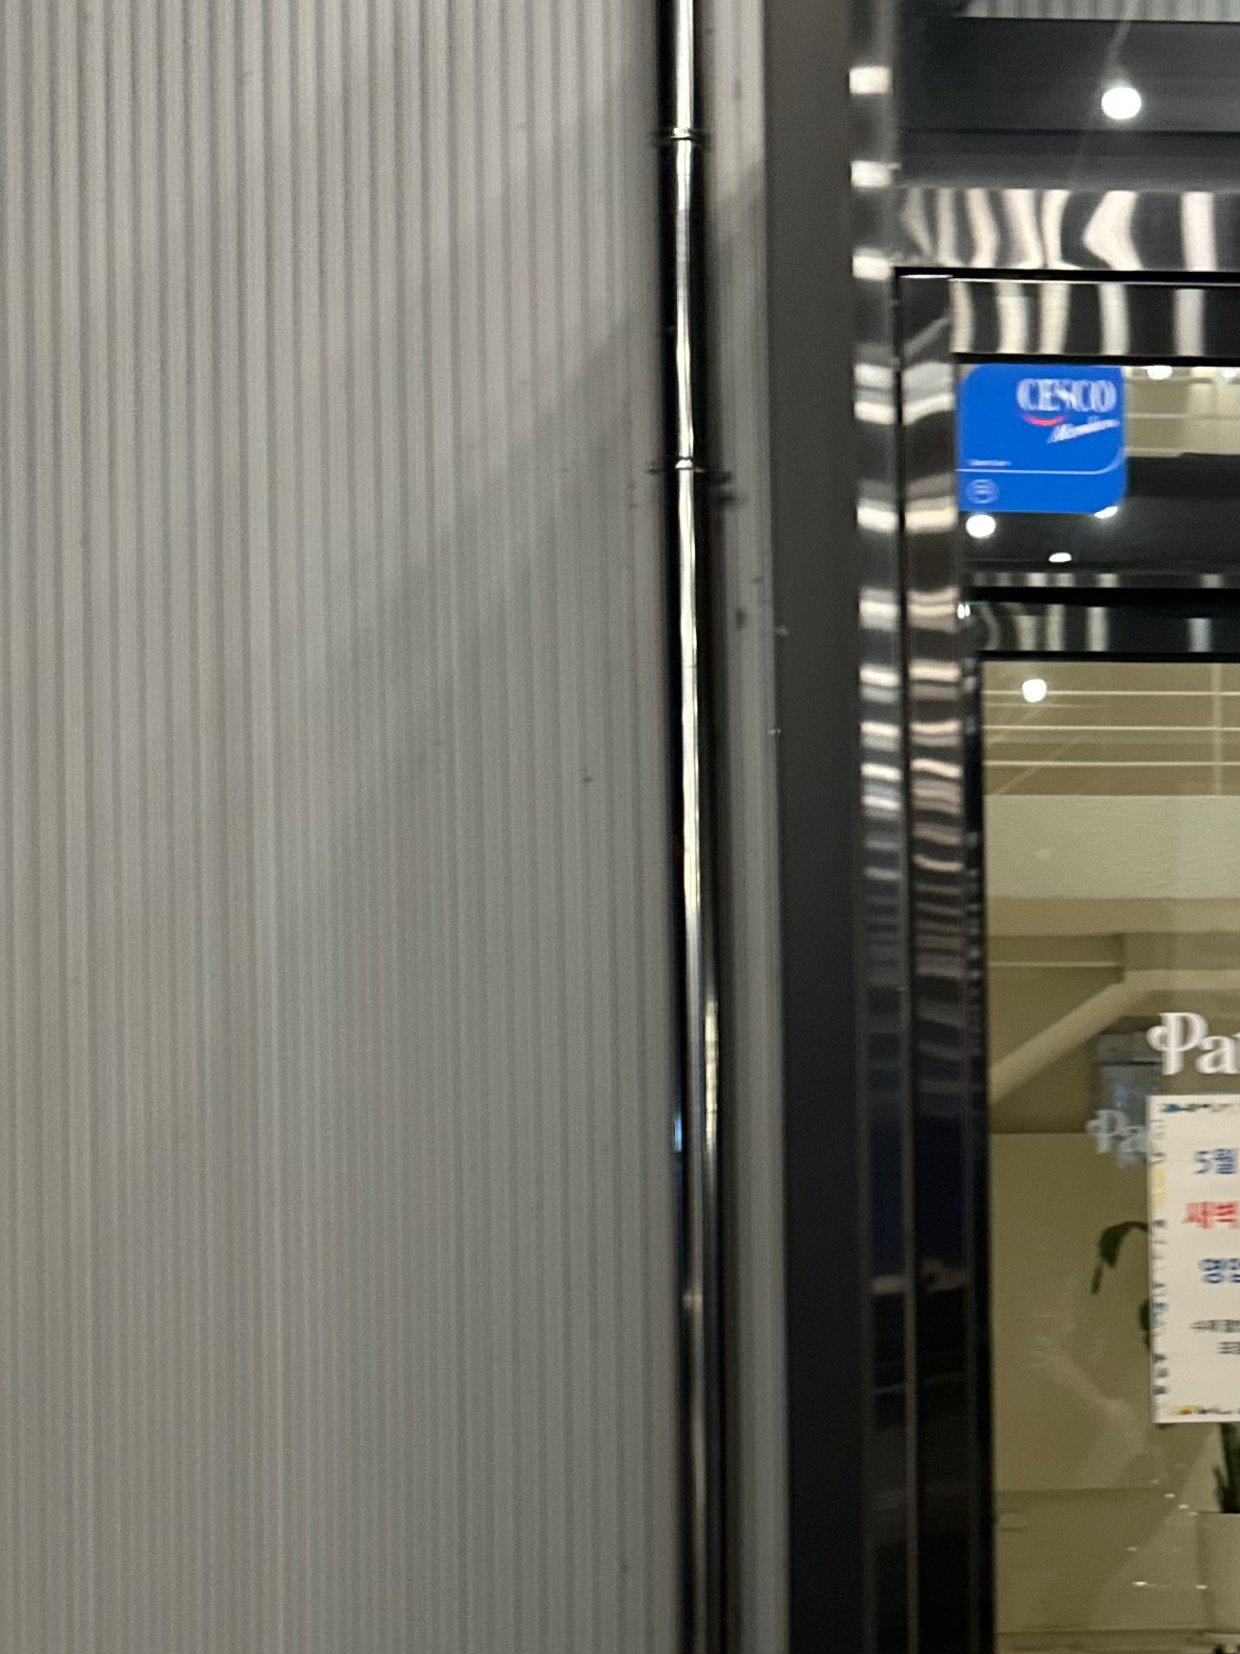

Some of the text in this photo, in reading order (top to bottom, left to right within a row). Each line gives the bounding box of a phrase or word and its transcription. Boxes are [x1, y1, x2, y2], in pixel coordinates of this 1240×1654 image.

[1016, 378, 1117, 412] CESCO
[1193, 1148, 1239, 1175] 5월
[1183, 1201, 1240, 1229] 새벽
